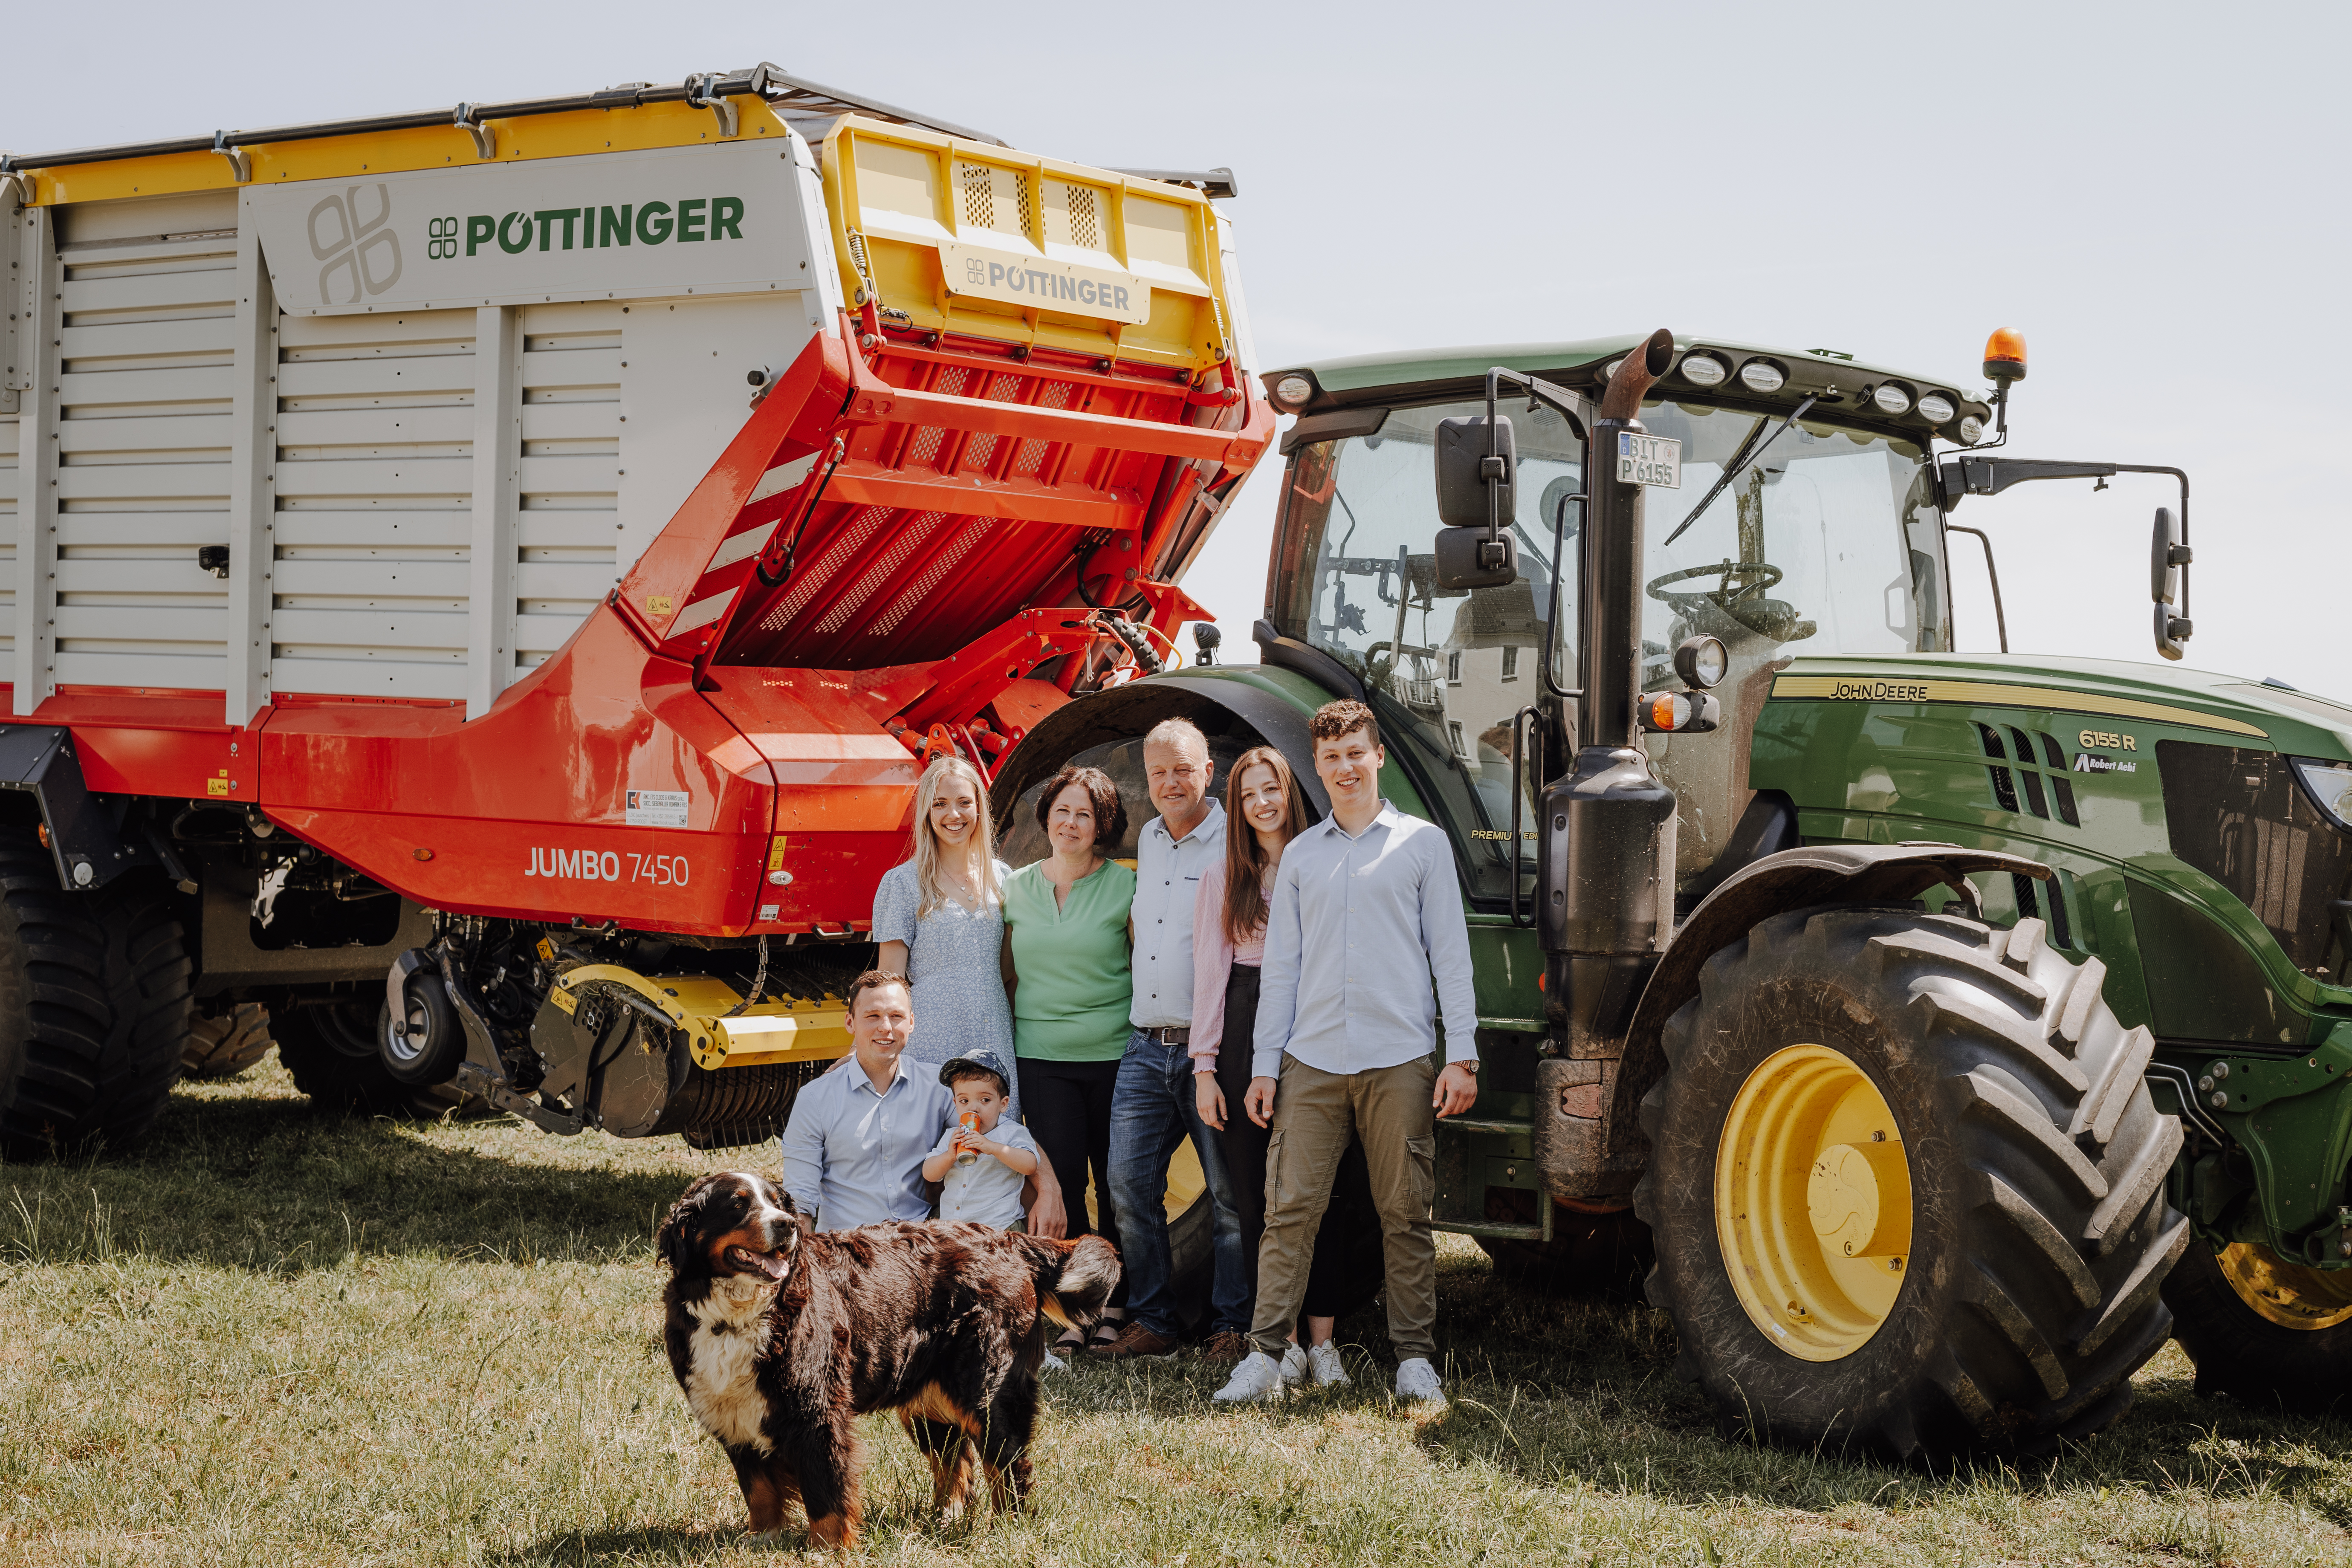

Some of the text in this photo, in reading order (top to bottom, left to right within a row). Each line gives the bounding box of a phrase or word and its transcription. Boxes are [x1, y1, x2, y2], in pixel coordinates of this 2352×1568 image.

[1630, 437, 1658, 460] BIT
[1623, 459, 1672, 484] P 6155
[1830, 681, 1928, 699] JOHN DEERE
[2078, 729, 2137, 752] 6155 R
[2090, 758, 2136, 772] Robert Aebi
[1471, 829, 1512, 841] PREMIU
[524, 847, 689, 886] JUMBO 7450
